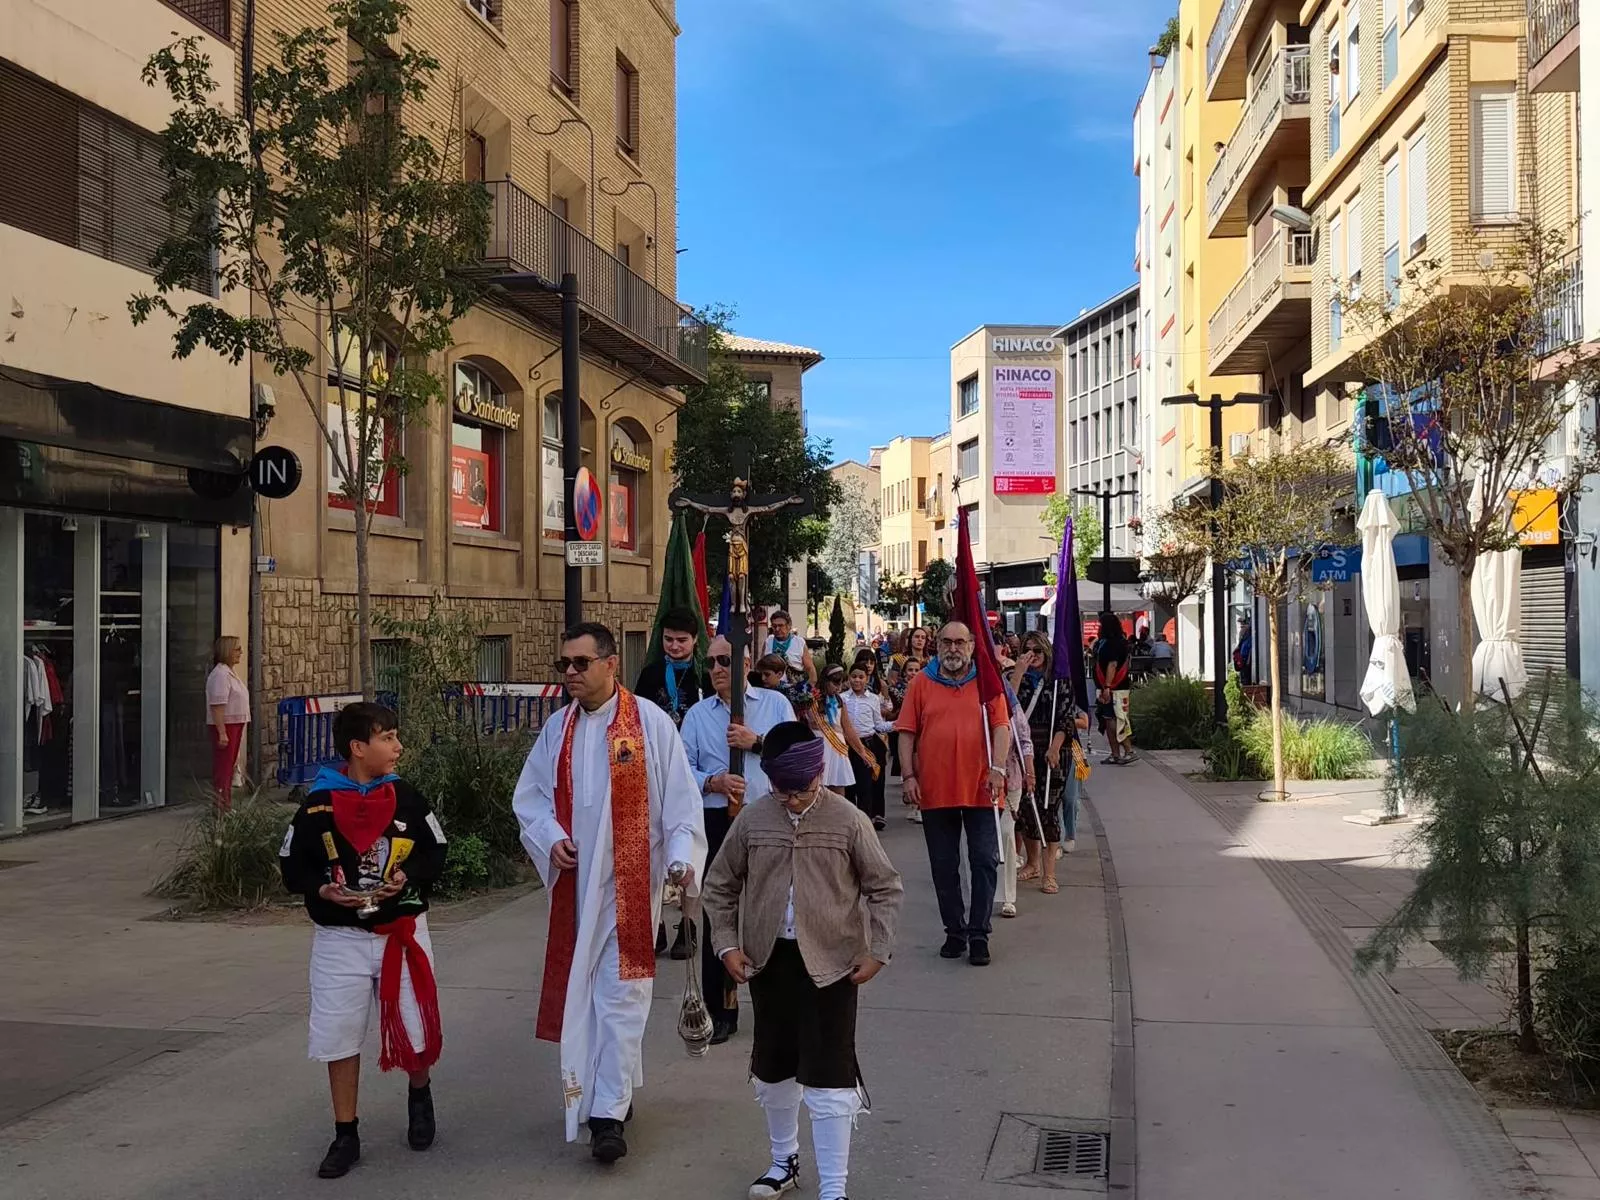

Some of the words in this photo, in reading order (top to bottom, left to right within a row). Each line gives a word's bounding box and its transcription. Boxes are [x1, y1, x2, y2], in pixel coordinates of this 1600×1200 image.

[992, 337, 1056, 352] HINACO
[995, 369, 1052, 381] HINACO
[472, 395, 521, 430] Santander
[622, 448, 651, 471] Santander
[259, 458, 286, 485] IN
[1319, 569, 1346, 580] ATM
